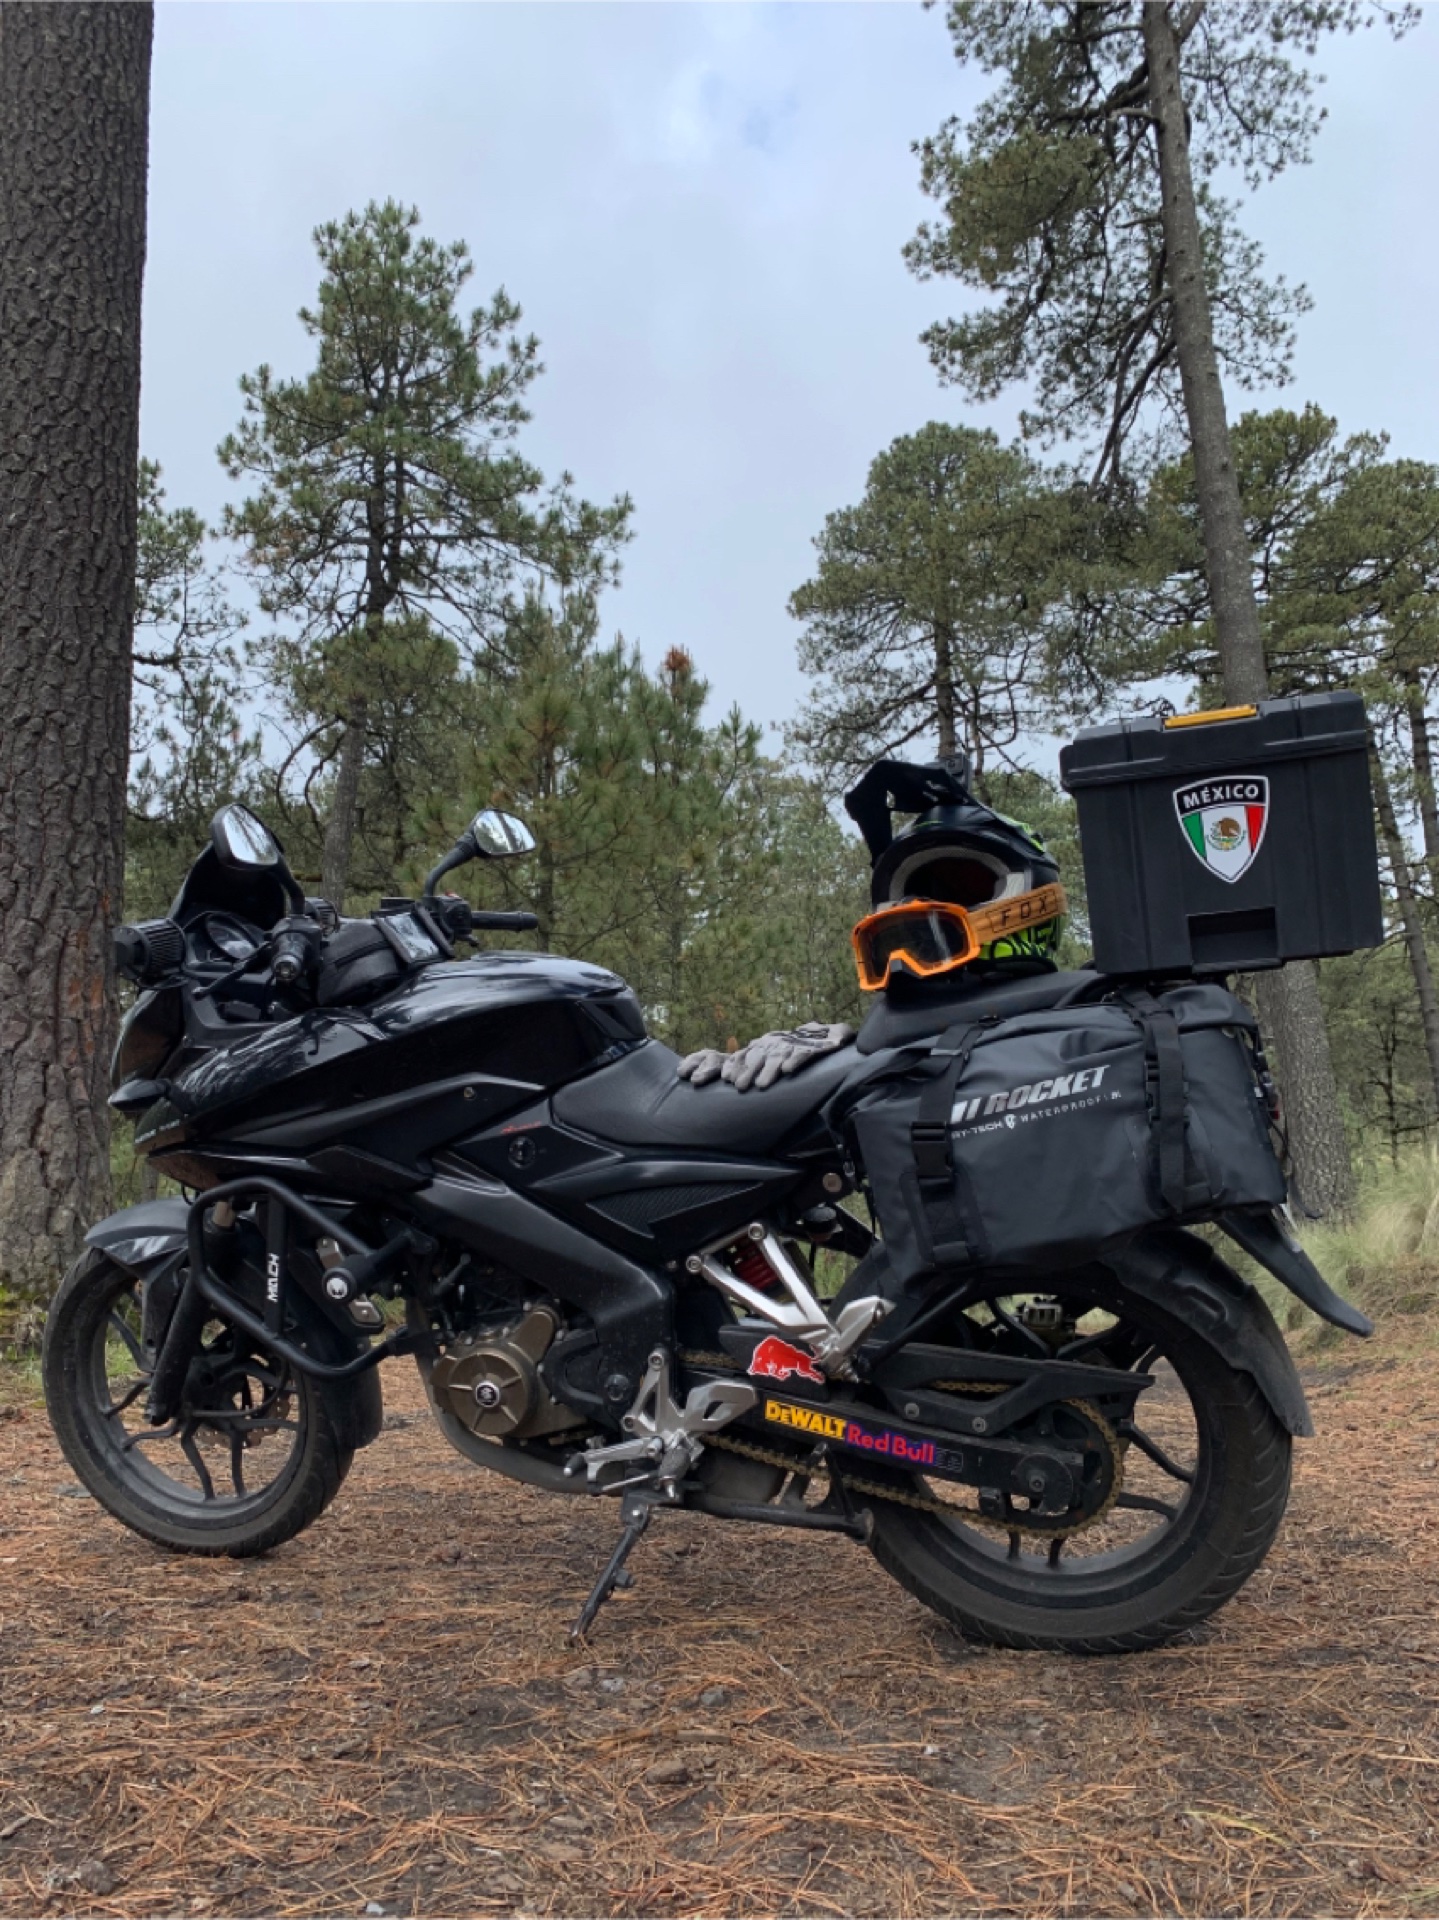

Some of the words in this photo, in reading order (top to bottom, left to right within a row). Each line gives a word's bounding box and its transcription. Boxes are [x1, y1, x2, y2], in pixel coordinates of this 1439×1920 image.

[1183, 783, 1259, 808] MÉXICO
[1001, 896, 1048, 926] FOX
[984, 1065, 1110, 1115] ROCKET
[847, 1423, 892, 1455] Red
[892, 1435, 935, 1465] Bull
